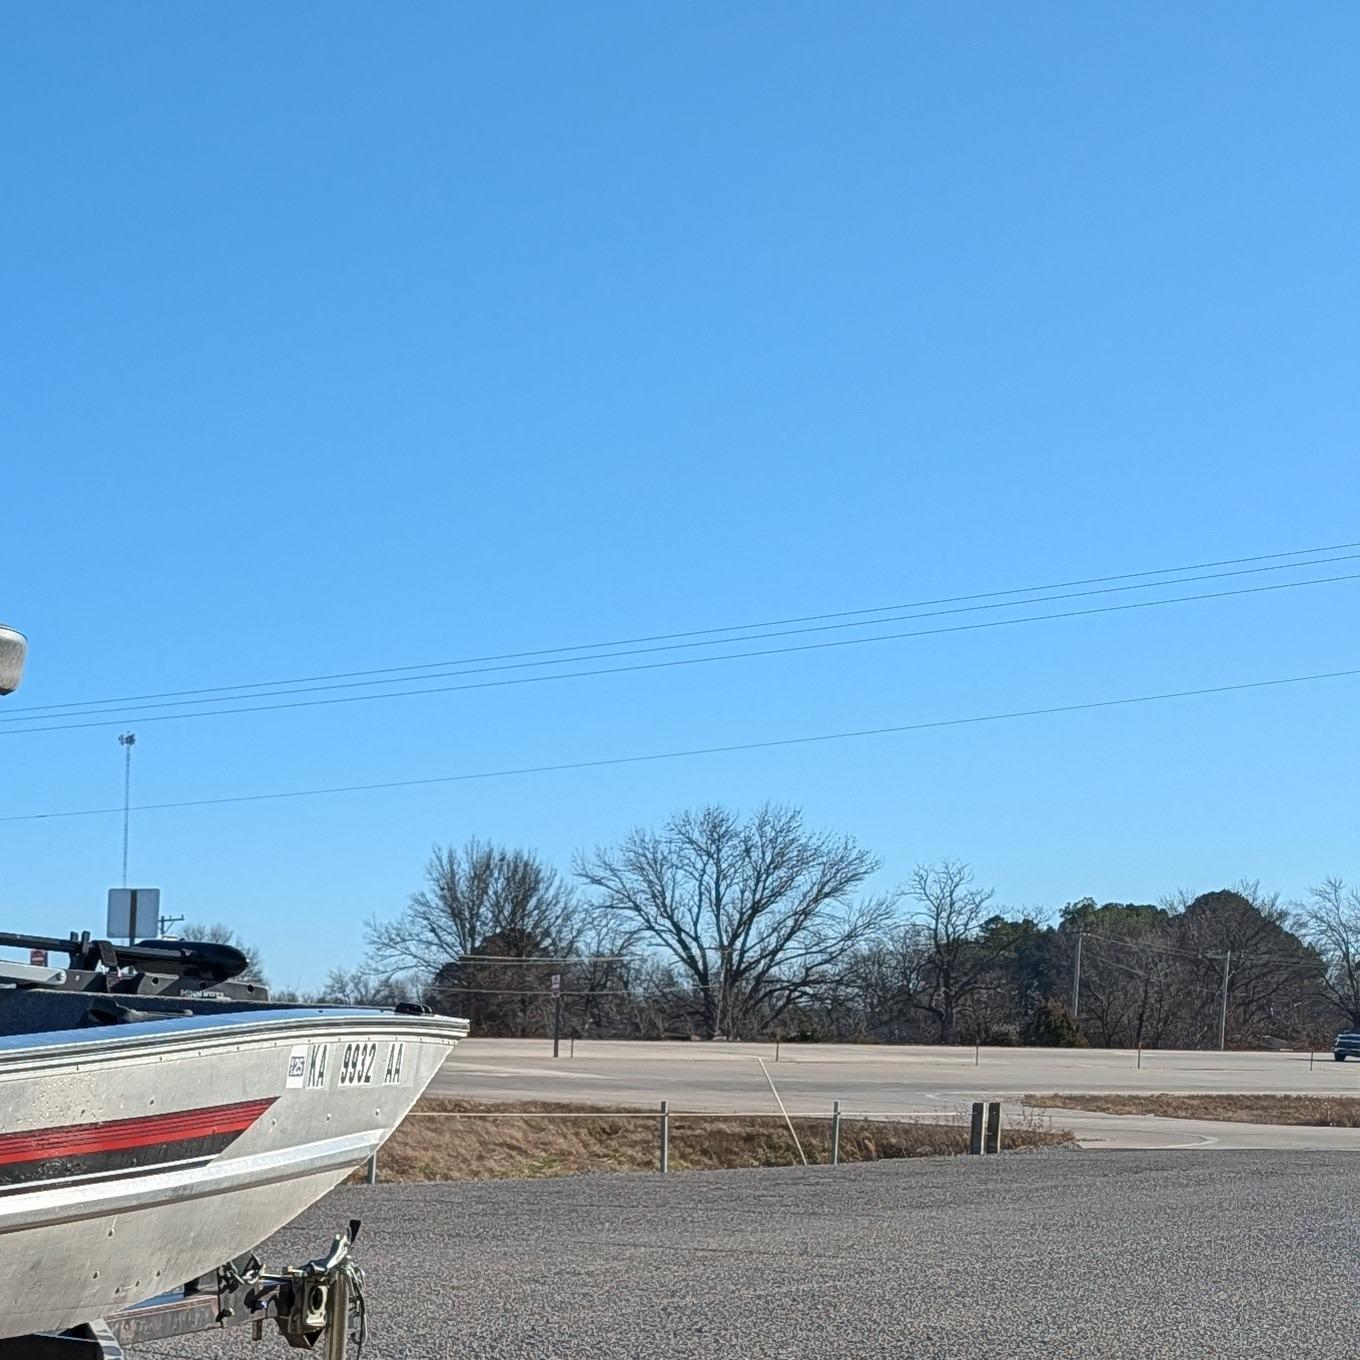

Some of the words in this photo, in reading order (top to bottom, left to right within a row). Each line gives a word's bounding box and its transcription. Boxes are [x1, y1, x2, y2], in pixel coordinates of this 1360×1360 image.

[307, 1044, 328, 1087] KA
[340, 1042, 377, 1084] 9932
[384, 1043, 404, 1084] AA
